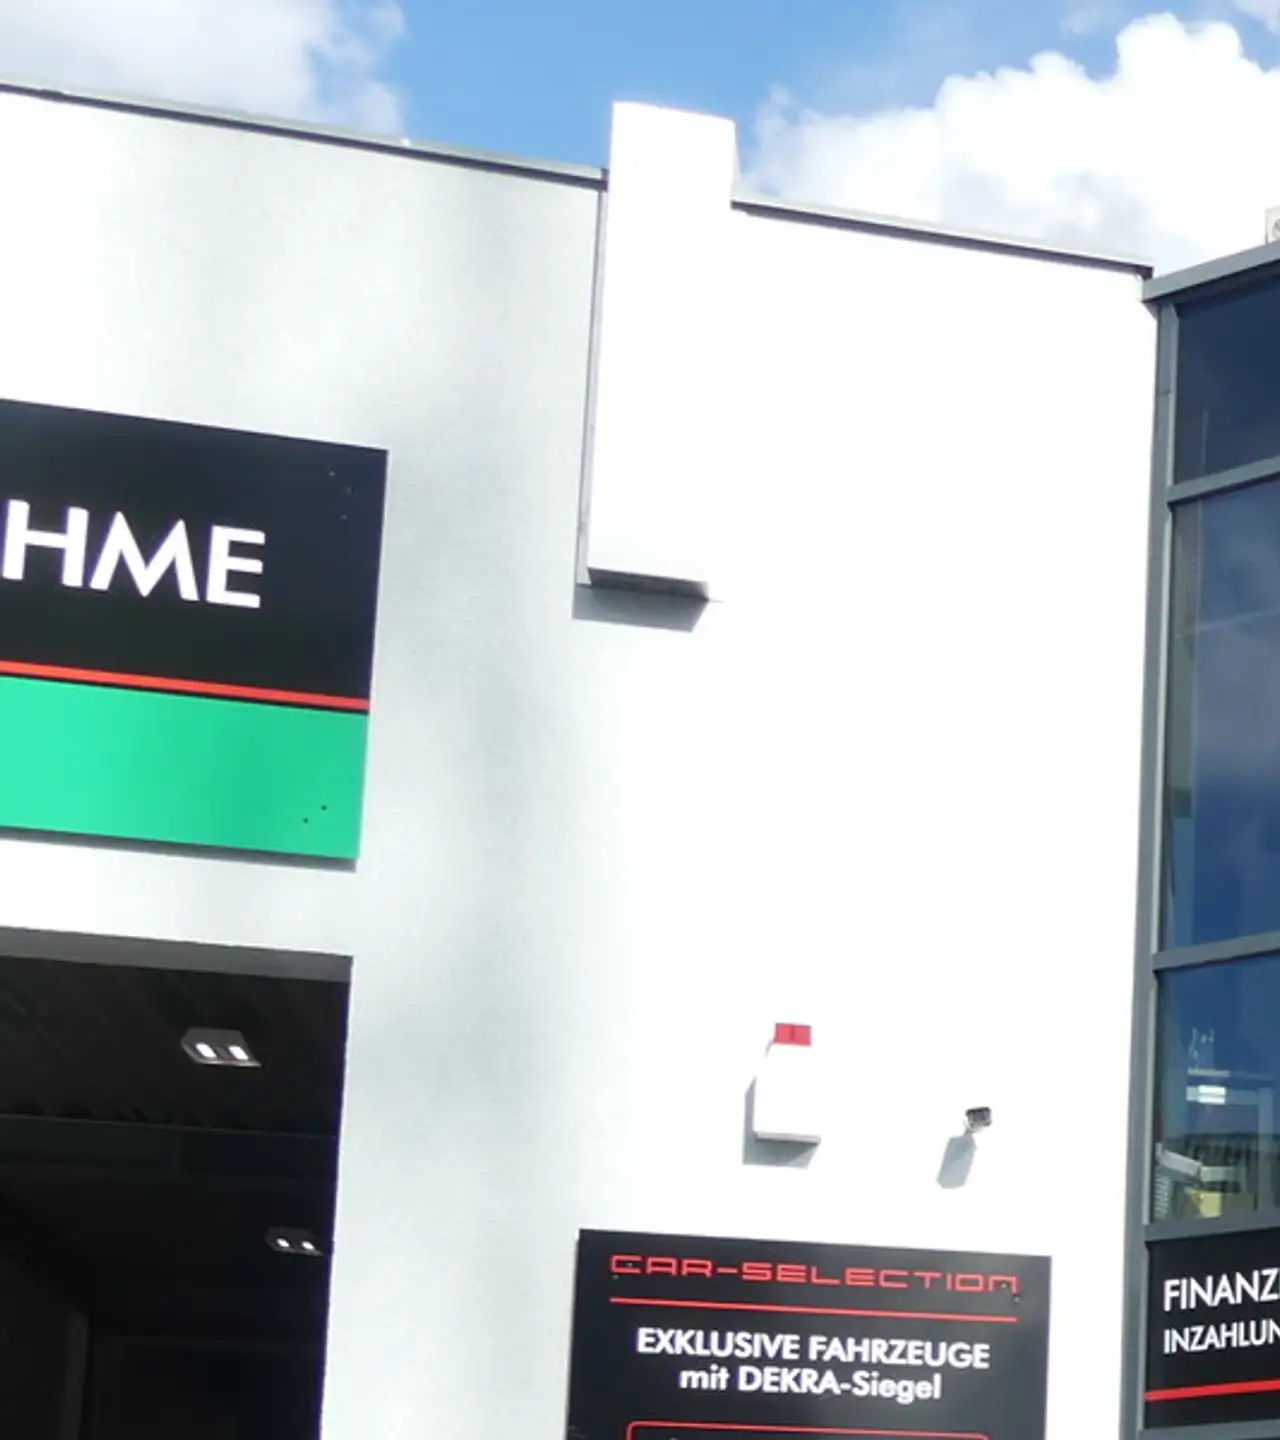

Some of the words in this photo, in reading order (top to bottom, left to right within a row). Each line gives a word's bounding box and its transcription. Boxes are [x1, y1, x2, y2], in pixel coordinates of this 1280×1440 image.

[609, 1253, 1019, 1293] CAR-SELECTION
[635, 1325, 801, 1361] EXKLUSIVE
[808, 1334, 992, 1370] FAHRZEUGE
[678, 1363, 732, 1391] mit
[737, 1365, 943, 1405] DEKRA-Siegel
